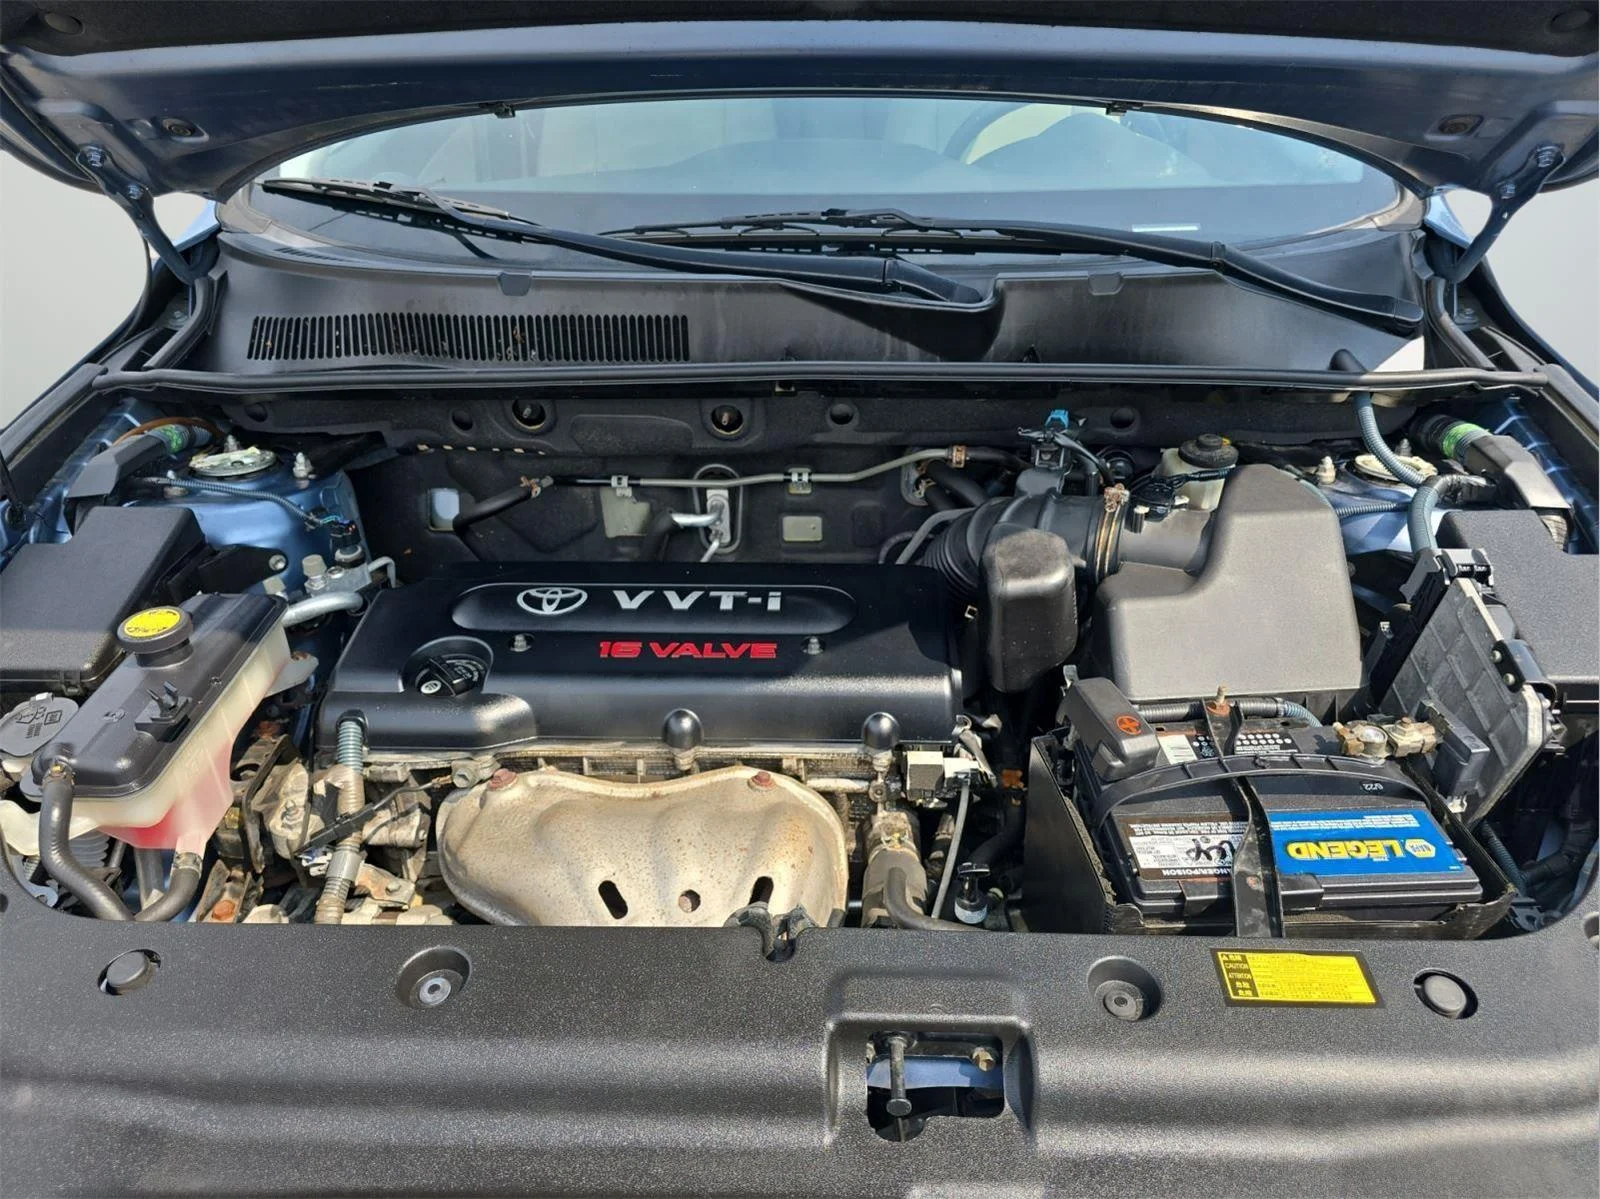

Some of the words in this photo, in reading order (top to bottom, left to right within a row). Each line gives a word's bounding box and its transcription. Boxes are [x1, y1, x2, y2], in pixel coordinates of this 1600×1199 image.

[612, 590, 782, 611] VVT-i
[600, 641, 642, 658] 16
[650, 642, 778, 659] VALVE
[1286, 839, 1405, 861] LEGEND
[1162, 867, 1231, 876] ANGER/POISON
